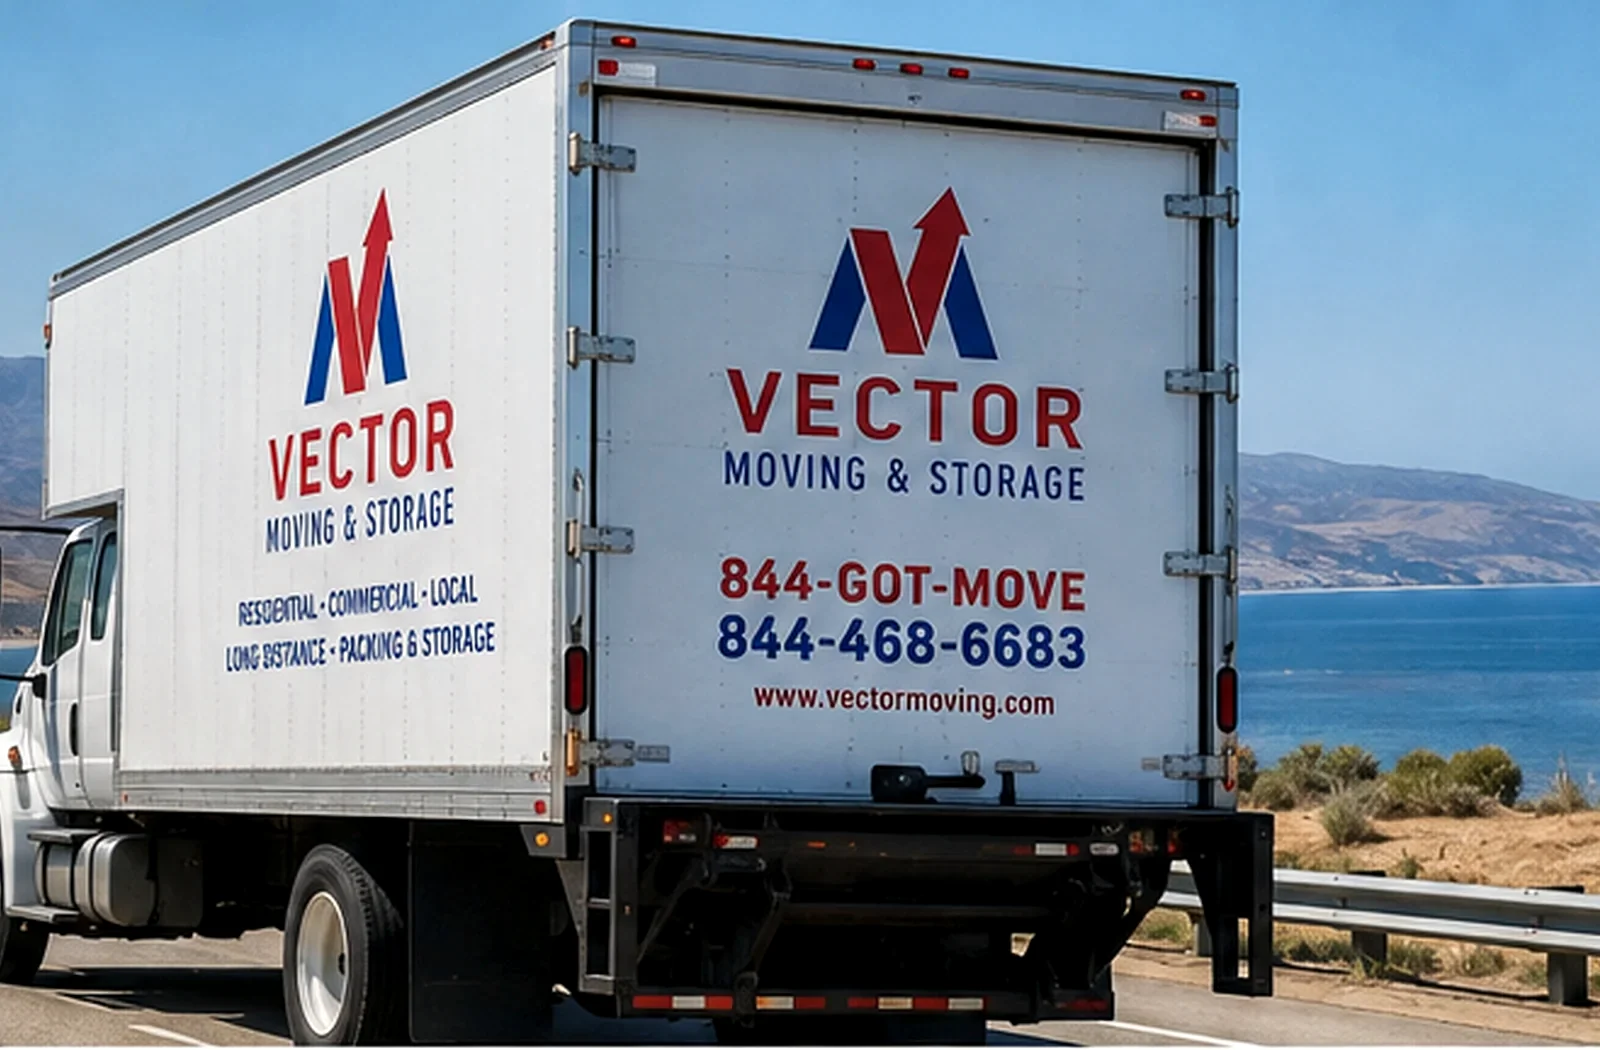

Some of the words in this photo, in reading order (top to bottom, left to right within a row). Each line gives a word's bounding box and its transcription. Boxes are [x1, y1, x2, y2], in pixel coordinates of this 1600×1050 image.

[726, 368, 1083, 449] VECTOR
[268, 399, 454, 501] VECTOR
[724, 450, 865, 491] MOVING
[887, 458, 909, 494] &
[929, 460, 1084, 500] STORAGE
[266, 509, 334, 553] MOVING
[343, 504, 356, 540] &
[366, 487, 454, 538] STORAGE
[430, 574, 478, 606] LOCAL
[720, 557, 1085, 611] 844-GOT-MOVE
[226, 644, 261, 672] LONG
[339, 630, 403, 663] PACKING
[421, 621, 496, 657] STORAGE
[718, 614, 1085, 669] 844-468-6683
[753, 686, 1055, 720] www.vectormoving.com
